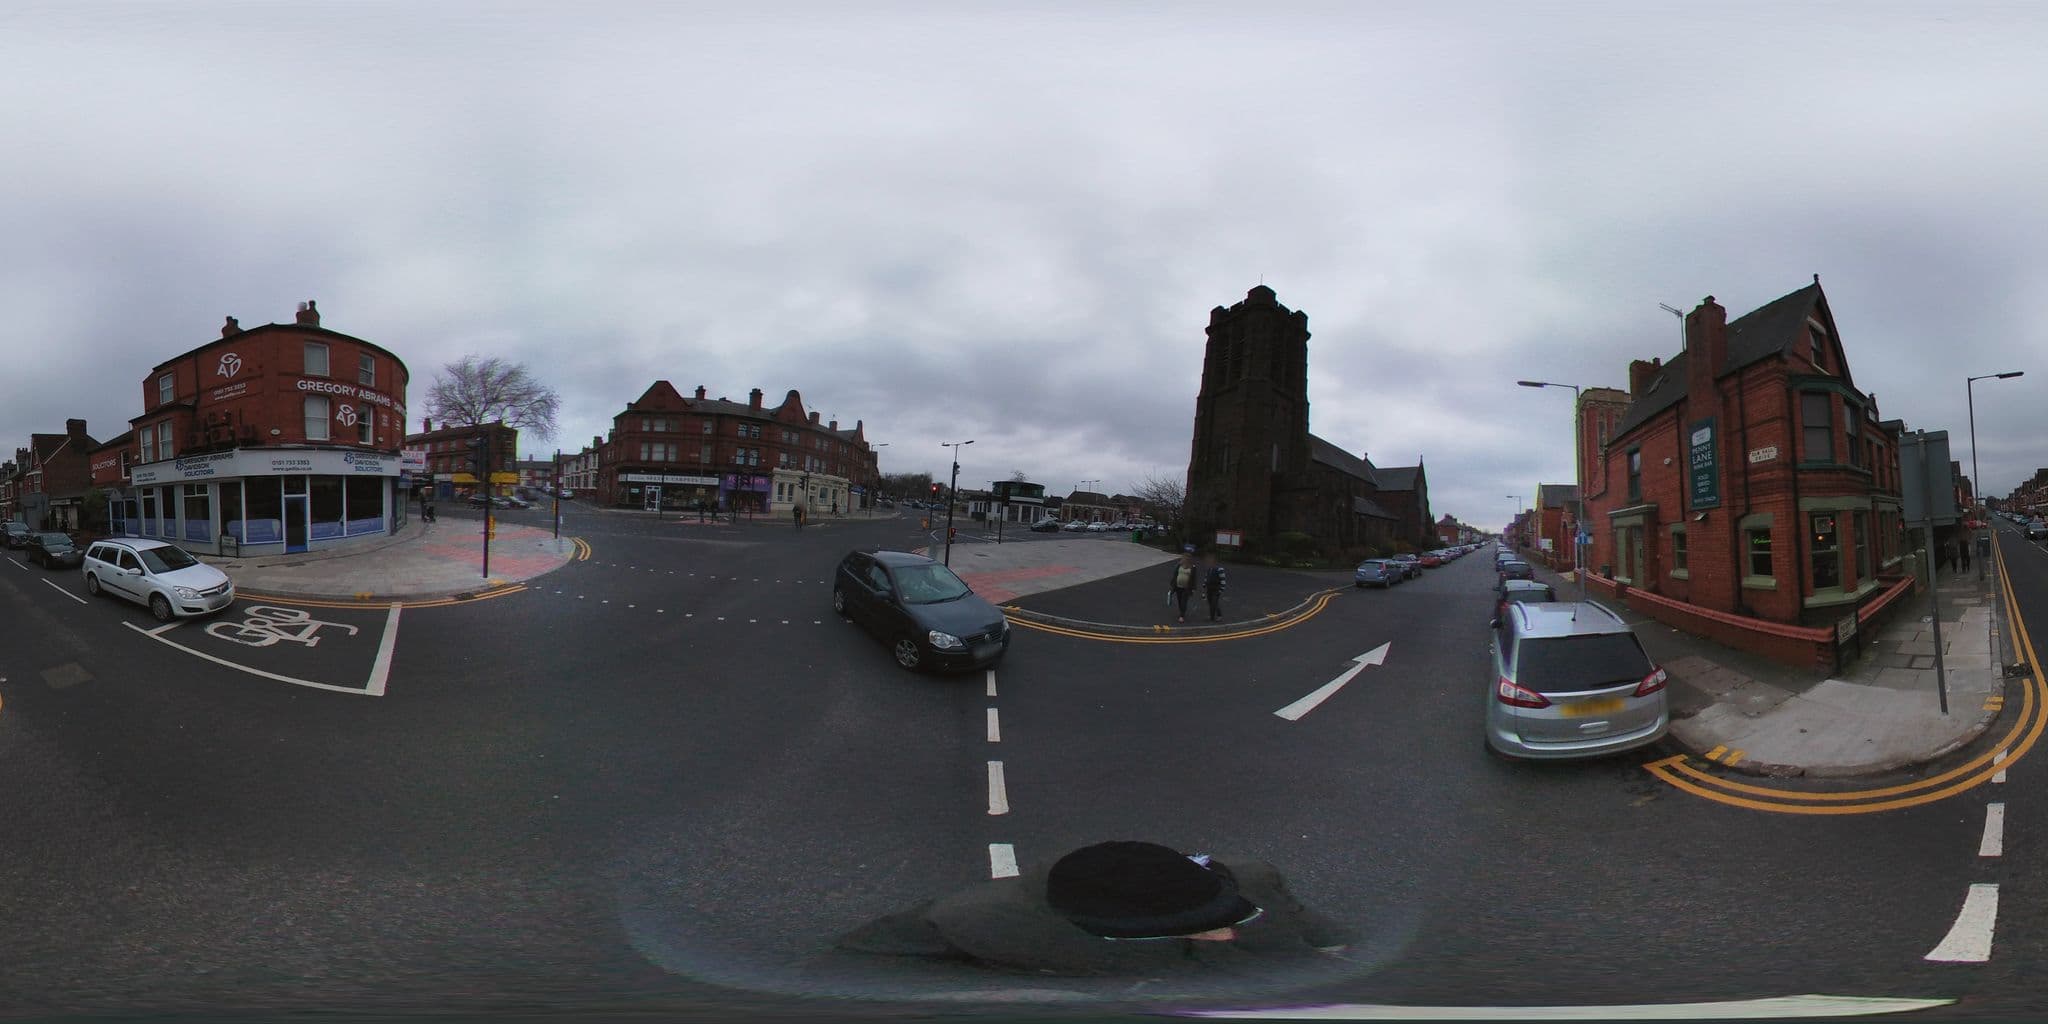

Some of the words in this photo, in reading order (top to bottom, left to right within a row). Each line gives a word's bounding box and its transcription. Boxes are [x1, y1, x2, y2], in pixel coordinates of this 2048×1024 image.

[297, 380, 356, 397] GREGORY
[358, 389, 391, 407] ABRAMS
[1692, 442, 1711, 454] PENNY
[1692, 450, 1712, 464] LANE
[92, 459, 117, 471] SOLICITORS
[184, 468, 215, 477] SOLICITORS
